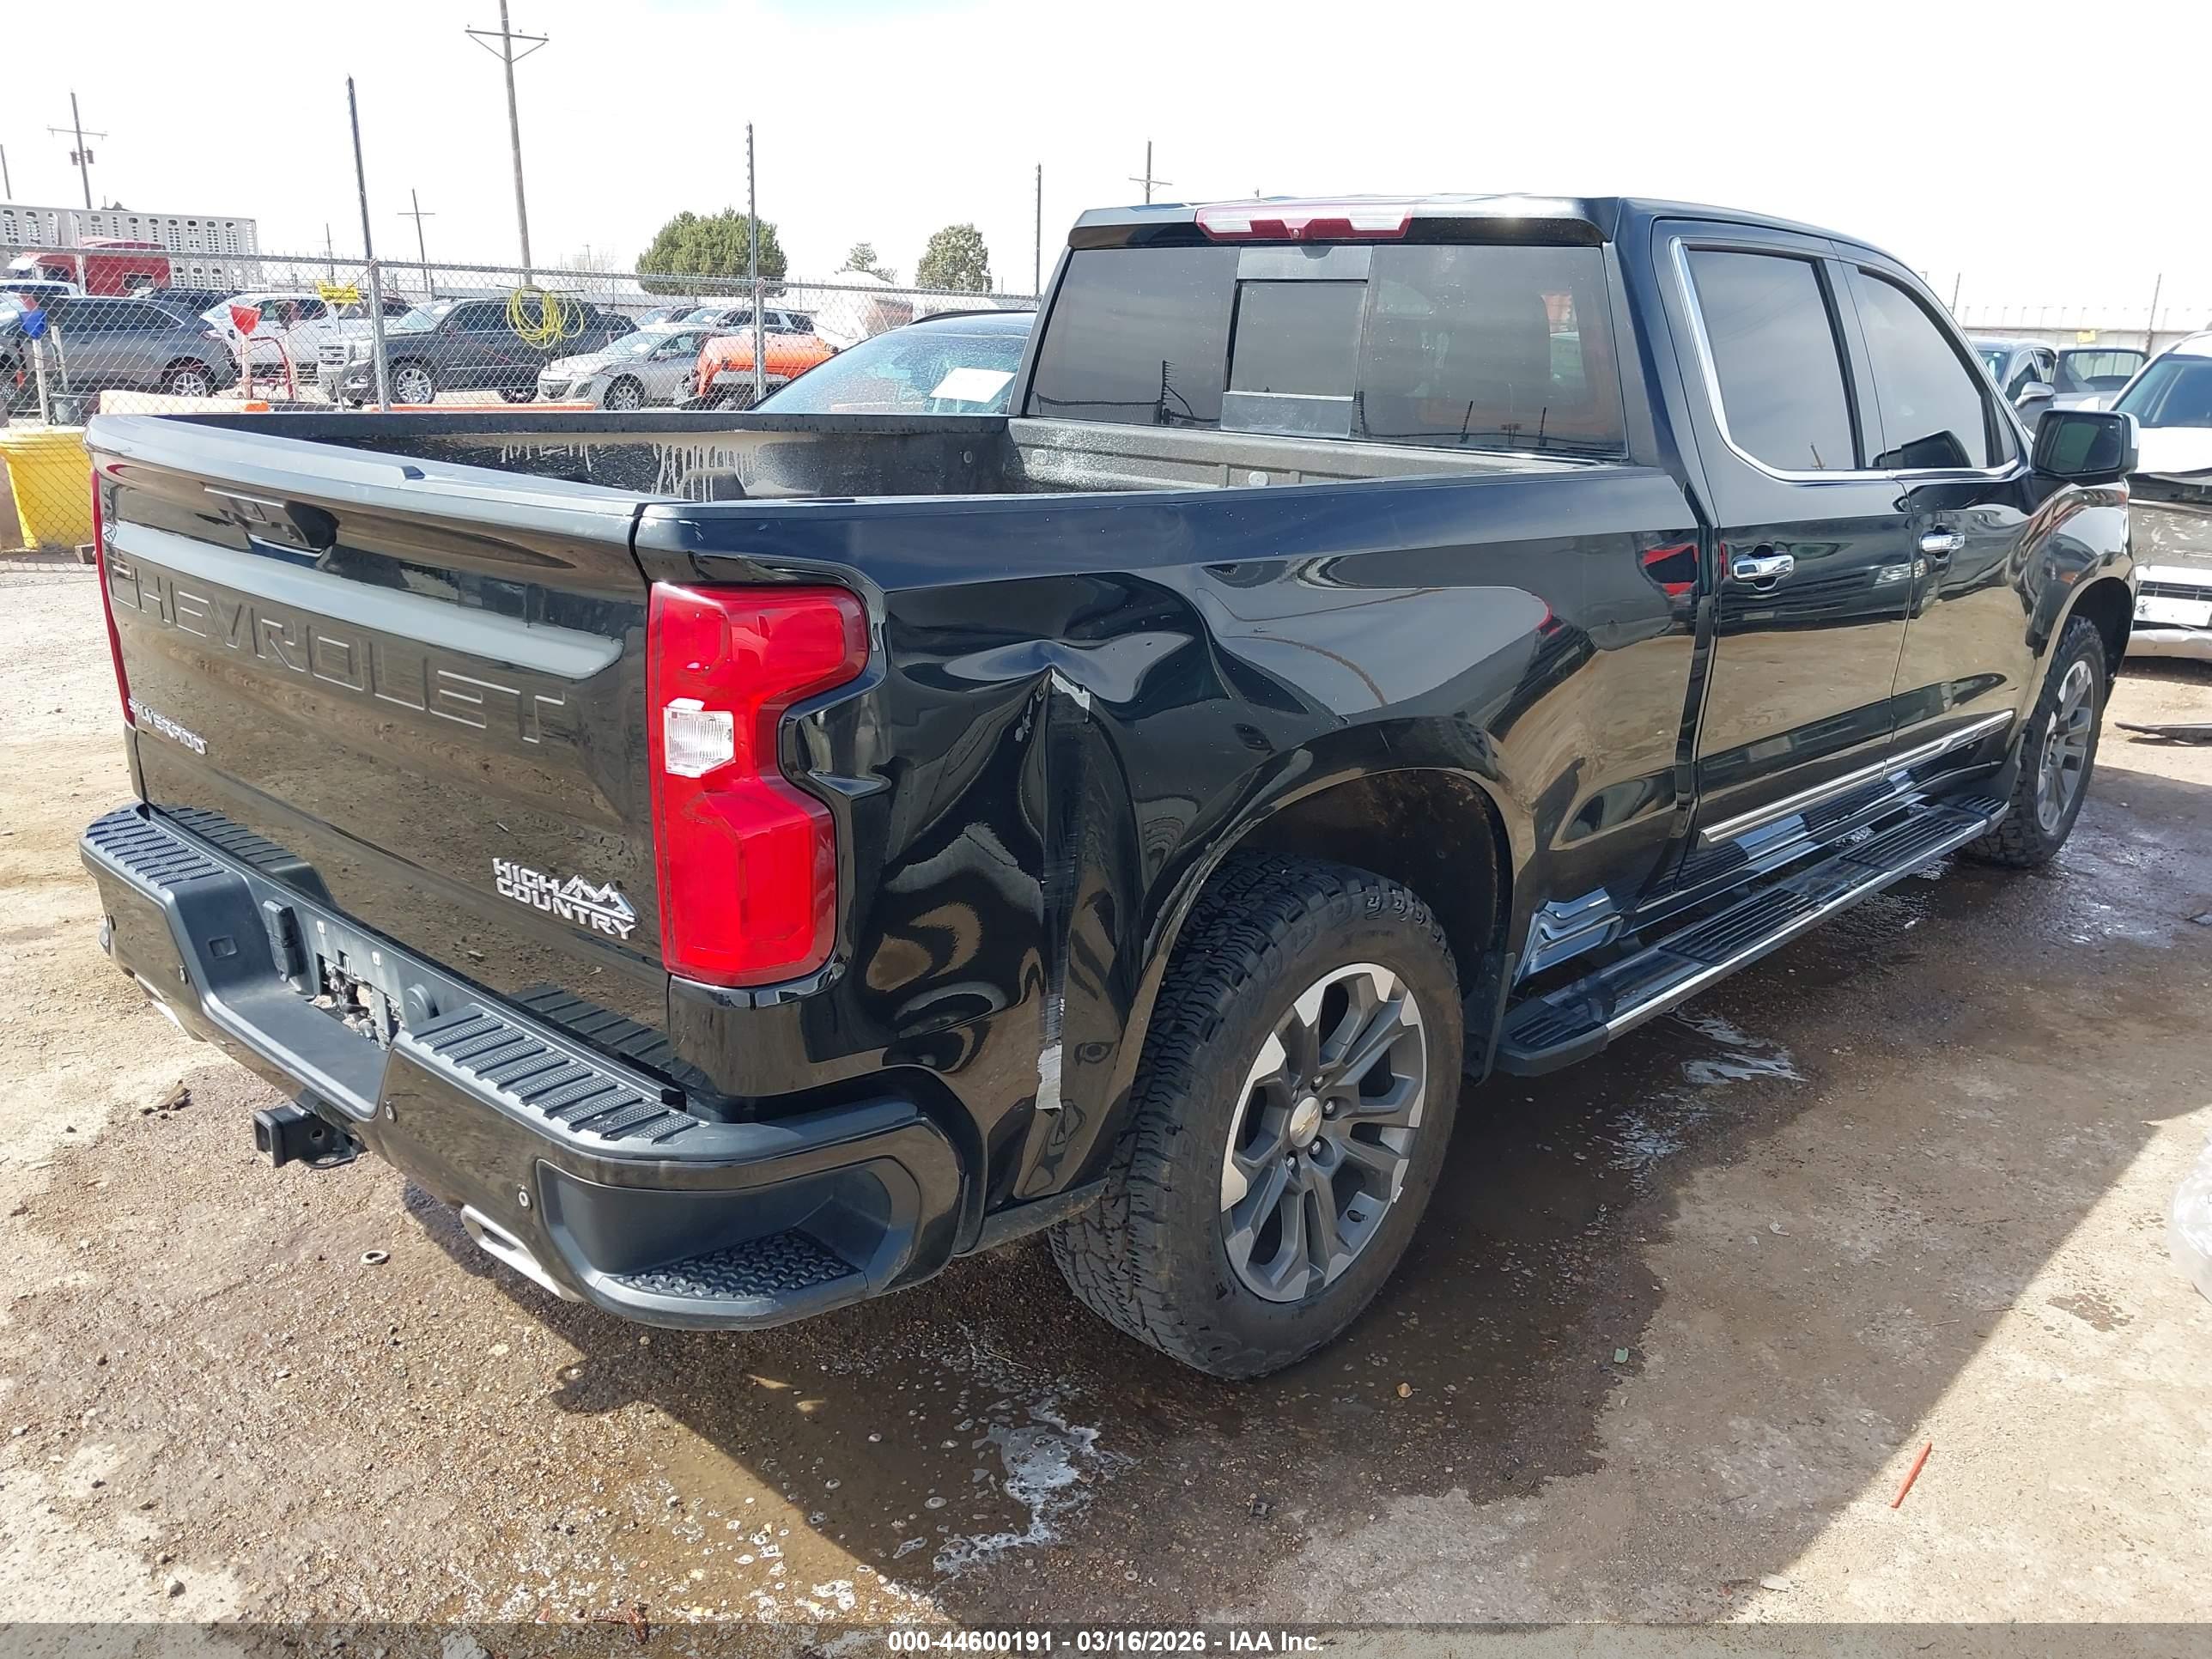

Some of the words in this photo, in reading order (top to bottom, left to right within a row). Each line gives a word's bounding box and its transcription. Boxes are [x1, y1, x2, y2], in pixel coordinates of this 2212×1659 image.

[107, 550, 567, 744] CHEVROLET
[127, 696, 208, 756] SILVERADO
[492, 857, 562, 896] HIGH
[495, 876, 637, 941] COUNTRY
